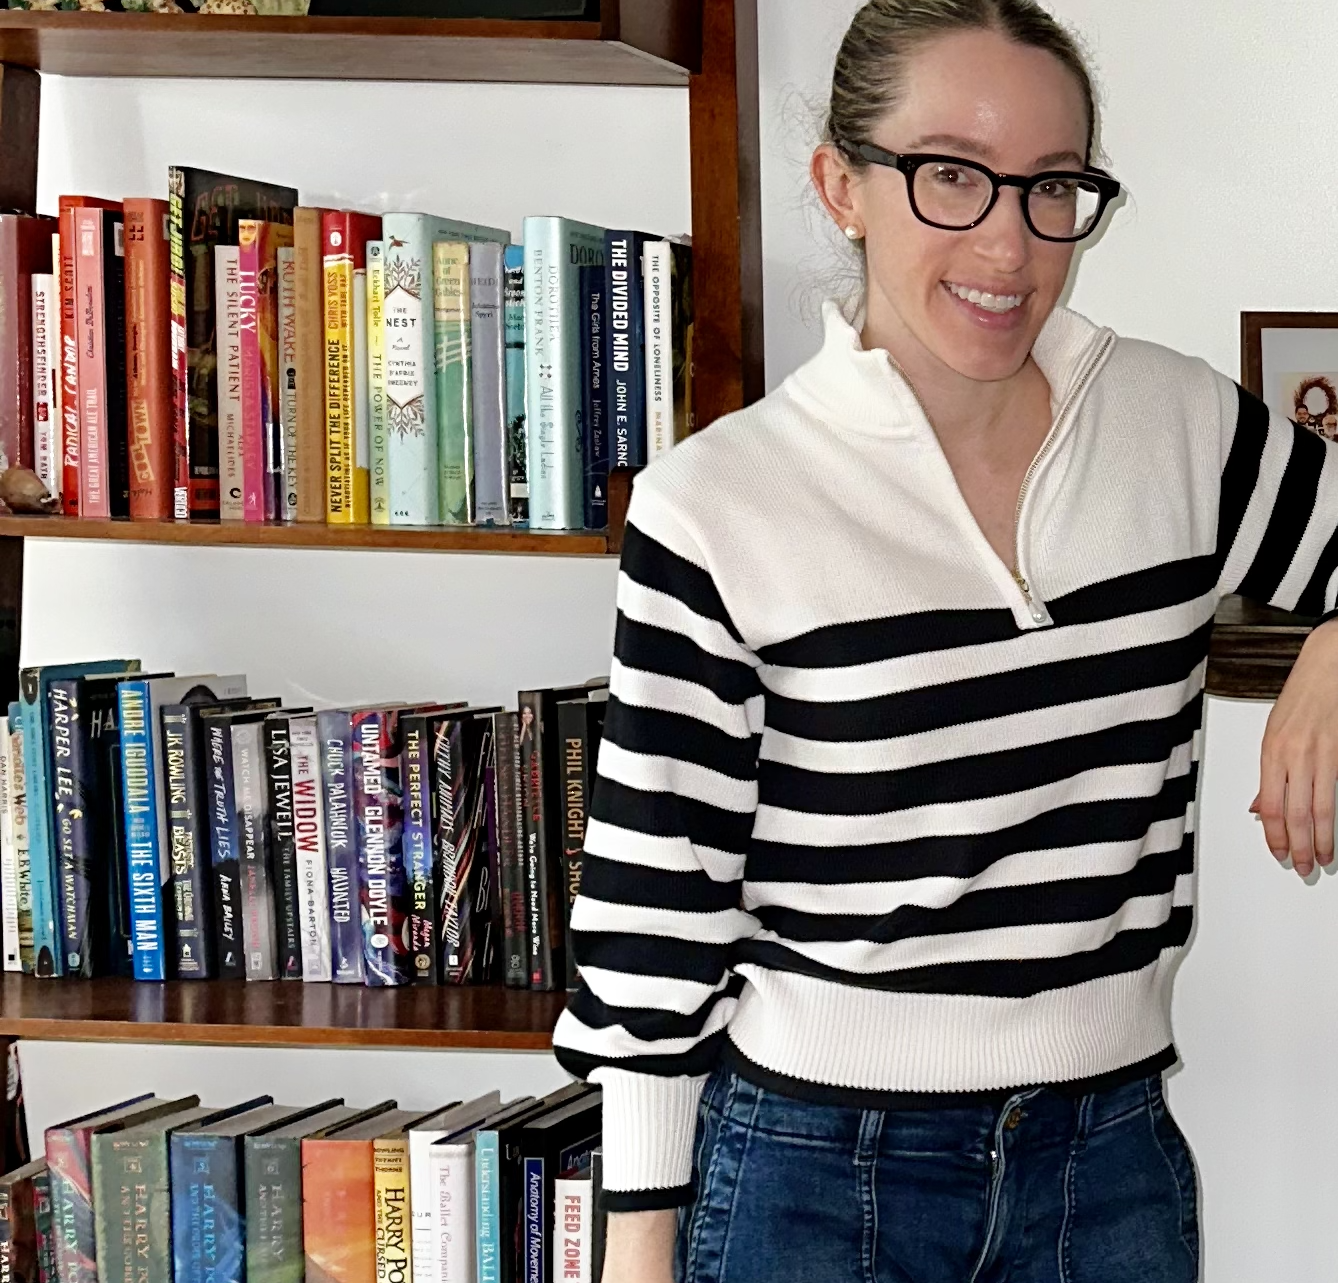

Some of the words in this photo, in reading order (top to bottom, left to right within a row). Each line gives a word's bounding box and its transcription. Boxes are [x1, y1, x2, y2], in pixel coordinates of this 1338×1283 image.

[226, 259, 238, 284] THE
[611, 240, 627, 267] THE
[326, 272, 337, 297] VOSS
[533, 249, 544, 307] BENTON
[226, 291, 239, 338] SILENT
[239, 270, 256, 334] LUCKY
[327, 300, 338, 330] CHRIS
[548, 264, 560, 342] DOROTHEA
[591, 292, 600, 310] The
[612, 269, 628, 330] DIVIDED
[386, 318, 417, 328] NEST
[534, 310, 545, 356] FRANK
[592, 335, 601, 358] from
[613, 333, 629, 372] MIND
[228, 344, 240, 402] PATIENT
[327, 339, 340, 410] DIFFERENCE
[372, 354, 383, 379] THE
[592, 360, 601, 389] Ames
[654, 343, 662, 402] LONELINESS
[373, 385, 384, 431] POWER
[615, 379, 627, 412] JOHN
[132, 401, 150, 444] TOWN
[328, 414, 340, 436] THE
[616, 415, 627, 425] E.
[133, 445, 153, 481] COOL
[329, 439, 341, 472] SPLIT
[374, 435, 384, 453] OF
[374, 458, 385, 487] NOW
[329, 475, 342, 513] NEVER
[53, 688, 71, 758] HARPER
[121, 689, 145, 736] ANDRE
[209, 727, 226, 764] WHERE
[270, 729, 289, 769] LISA
[327, 738, 343, 776] CHUCK
[360, 723, 383, 795] UNTAMED
[405, 729, 420, 759] THE
[565, 738, 582, 775] PHIL
[57, 767, 73, 797] LEE
[124, 743, 150, 814] IGUODALA
[167, 749, 187, 804] ROWLING
[240, 748, 251, 783] WATCH
[297, 755, 309, 775] THE
[13, 793, 28, 826] Web
[212, 783, 229, 824] TRUTH
[272, 773, 292, 842] JEWELL
[328, 779, 348, 848] PALAHNIUK
[408, 763, 423, 828] PERFECT
[566, 779, 584, 841] KNIGHT
[61, 818, 72, 834] GO
[242, 803, 256, 860] DISAPPEAR
[293, 779, 319, 853] WIDOW
[62, 838, 74, 858] SET
[131, 842, 153, 867] THE
[171, 825, 188, 875] BEASTS
[215, 826, 231, 859] LIES
[364, 806, 387, 875] GLENNON
[305, 859, 314, 895] FIONA
[411, 831, 426, 910] STRANGER
[528, 855, 538, 879] Going
[65, 873, 78, 940] WATCHMAN
[132, 872, 156, 914] SIXTH
[218, 874, 233, 901] ANNA
[330, 866, 351, 923] HAUNTED
[367, 878, 388, 926] DOYLE
[530, 890, 539, 912] Need
[135, 919, 158, 951] MAN
[221, 904, 234, 941] BAILEY
[307, 900, 317, 946] BARTON
[532, 935, 541, 956] Wine
[439, 1165, 451, 1186] The
[479, 1147, 495, 1238] Understanding
[439, 1190, 453, 1227] Ballet
[526, 1172, 541, 1222] Anatomy
[564, 1195, 581, 1232] FEED
[61, 1179, 78, 1255] HARRY
[134, 1184, 149, 1259] HARRY
[202, 1183, 216, 1261] HARRY
[270, 1184, 284, 1262] HARRY
[384, 1187, 405, 1253] HARRY
[527, 1223, 541, 1236] of
[376, 1227, 387, 1280] CURSED
[563, 1238, 580, 1279] ZONE
